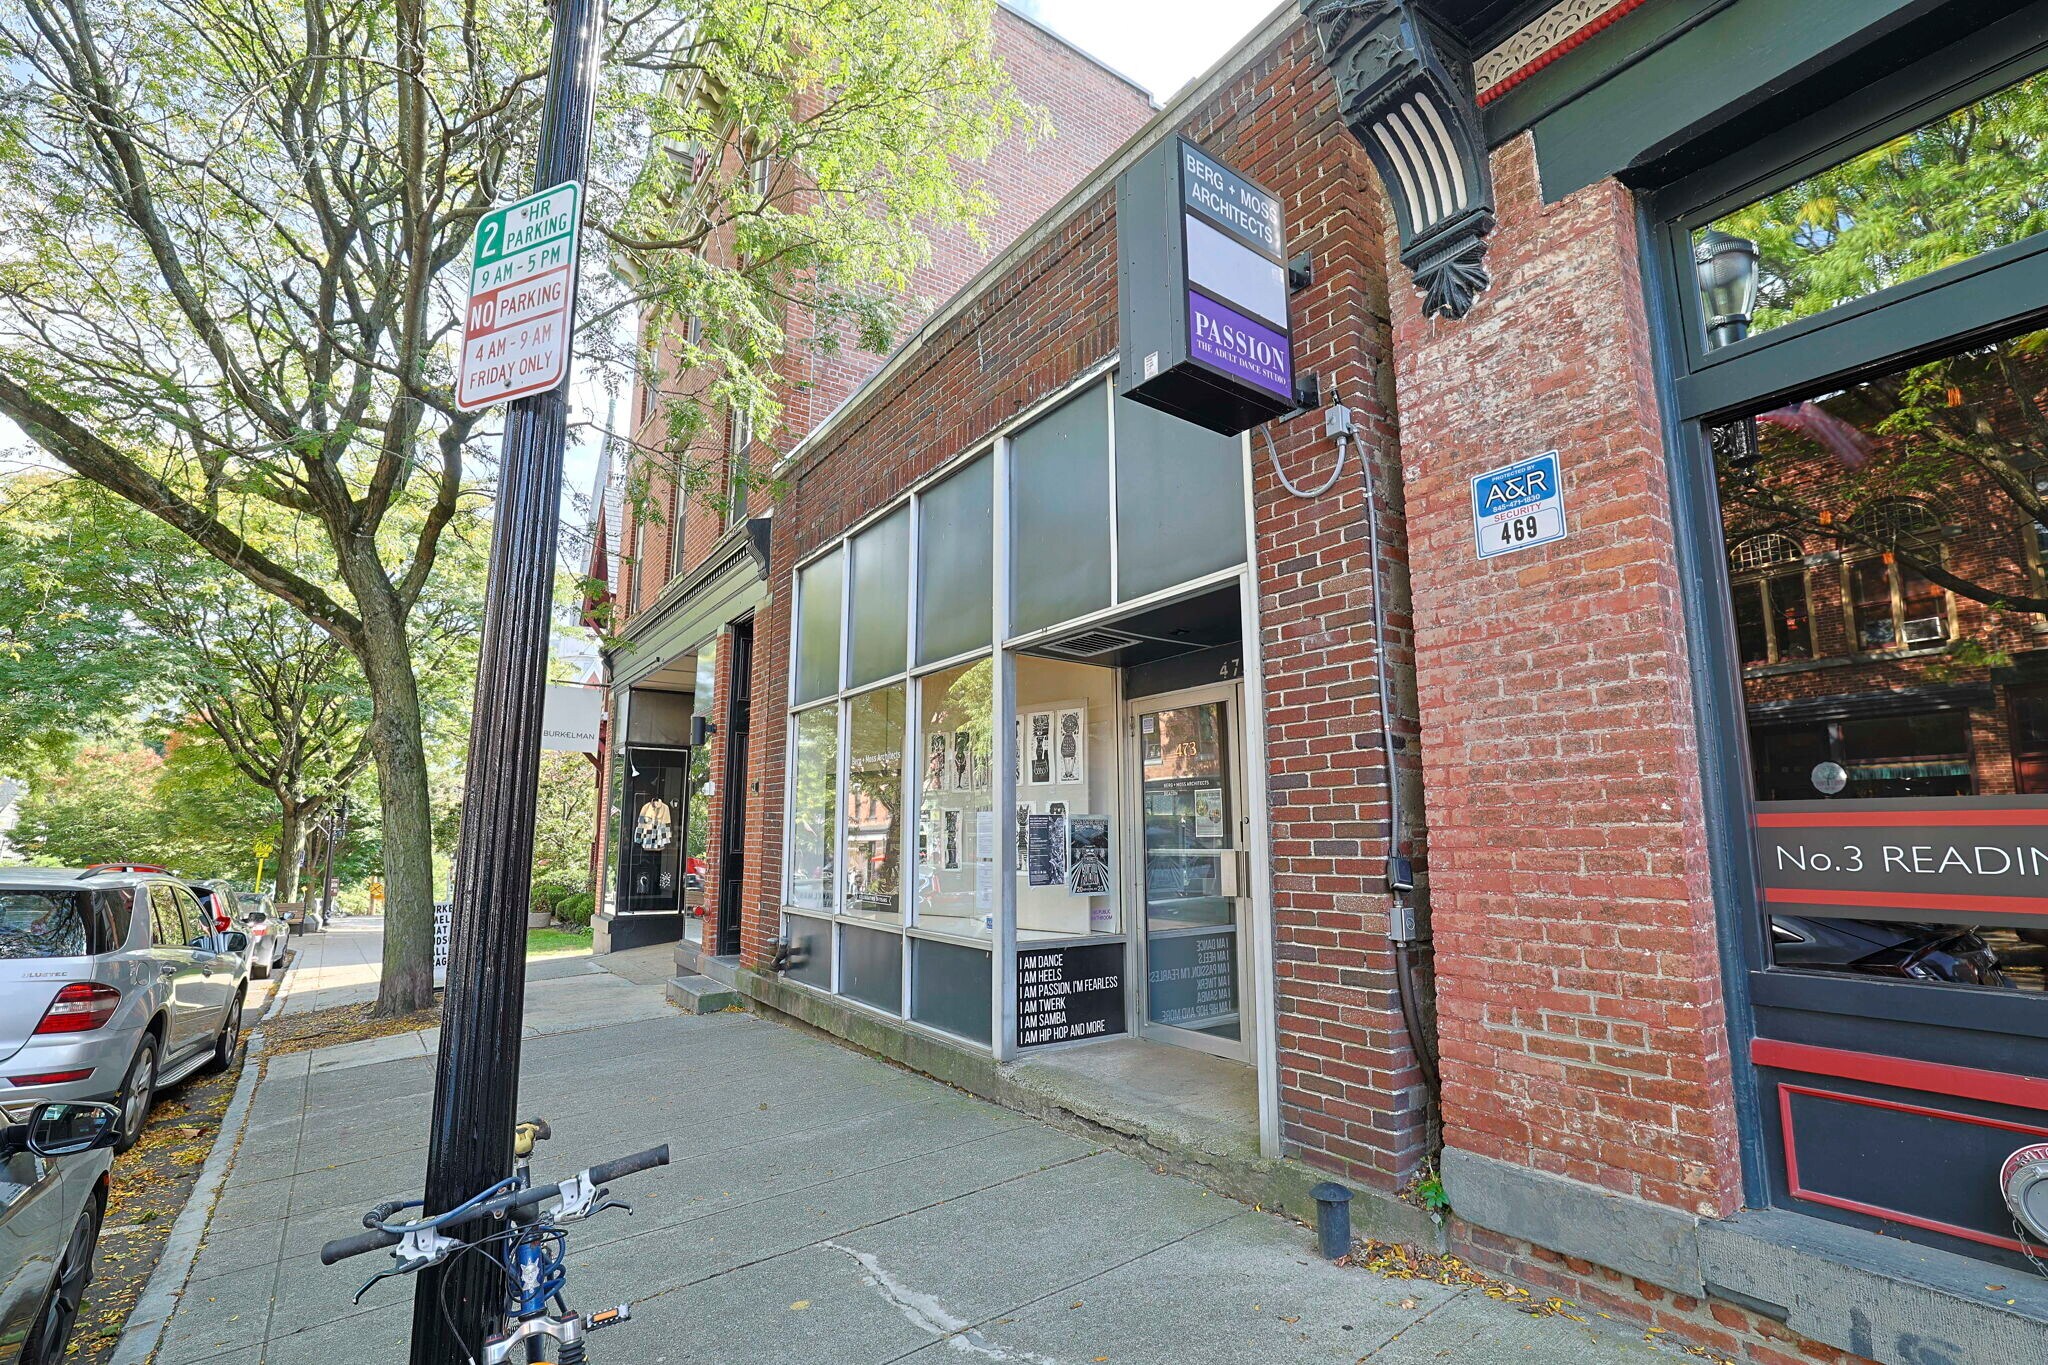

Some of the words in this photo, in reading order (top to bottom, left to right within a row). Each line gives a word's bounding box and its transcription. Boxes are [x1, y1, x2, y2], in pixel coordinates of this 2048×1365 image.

[1186, 153, 1224, 192] BERG
[1240, 190, 1279, 225] MOSS
[528, 200, 551, 222] HR
[1192, 182, 1274, 244] ARCHITECTS
[481, 221, 499, 259] 2
[507, 213, 567, 250] PARKING
[482, 270, 490, 289] 9
[493, 262, 512, 285] AM
[527, 254, 536, 273] 5
[540, 245, 561, 268] PM
[470, 300, 494, 332] NO
[500, 281, 561, 318] PARKING
[475, 344, 484, 362] 4
[487, 337, 507, 360] AM
[520, 329, 529, 349] 9
[531, 324, 552, 347] AM
[1194, 310, 1286, 374] PASSION
[469, 361, 516, 390] FRIDAY
[519, 351, 553, 376] ONLY
[1196, 339, 1212, 353] THE
[1214, 348, 1237, 364] ADULT
[1239, 358, 1261, 375] DANCE
[1262, 369, 1286, 385] STUDIO
[1492, 468, 1526, 482] PROTECTED
[1526, 464, 1536, 472] BY
[1485, 469, 1548, 509] A&R
[1494, 502, 1542, 523] SECURITY
[1501, 515, 1538, 545] 469
[543, 730, 595, 740] BURKELMAN
[1175, 741, 1197, 757] 473
[1776, 844, 1864, 873] No.3
[434, 904, 453, 914] RKE
[1023, 956, 1037, 970] AM
[1038, 953, 1064, 968] DANCE
[1023, 970, 1037, 985] AM
[1038, 968, 1062, 983] HEELS
[1023, 985, 1037, 999] AM
[1038, 981, 1072, 998] PASSION,
[1072, 979, 1084, 993] I'M
[1084, 975, 1118, 992] FEARLESS
[1024, 1000, 1038, 1014] AM
[1038, 996, 1067, 1012] TWERK
[1024, 1014, 1038, 1029] AM
[1038, 1011, 1067, 1027] SAMBA
[1024, 1030, 1038, 1044] AM
[1039, 1028, 1052, 1043] HIP
[1053, 1025, 1069, 1040] HOP
[1070, 1022, 1085, 1038] AND
[1086, 1019, 1106, 1035] MORE
